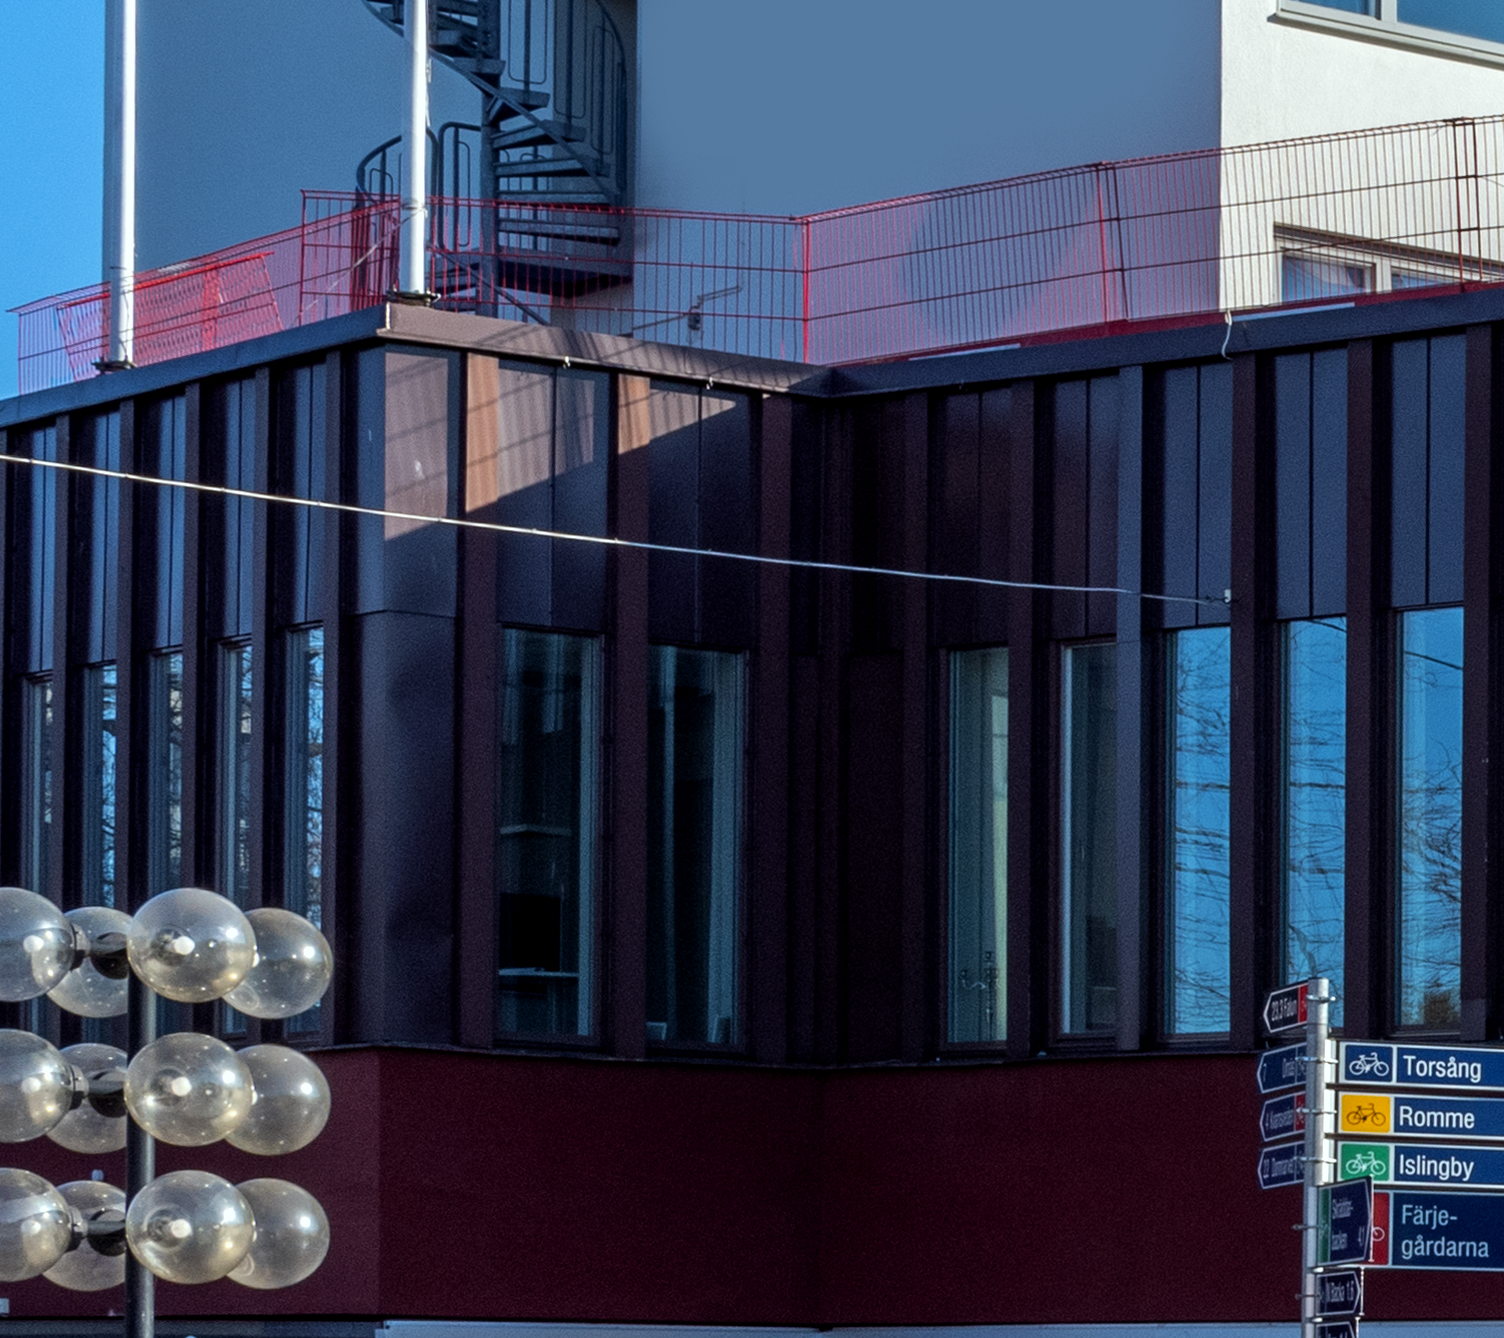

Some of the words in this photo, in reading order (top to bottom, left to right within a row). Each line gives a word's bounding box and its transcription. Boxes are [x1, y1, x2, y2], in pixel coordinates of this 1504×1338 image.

[1403, 1055, 1482, 1083] Torsång
[1399, 1105, 1475, 1129] Romme
[1399, 1154, 1474, 1181] Islingby
[1402, 1205, 1458, 1230] Färje-
[1401, 1235, 1489, 1260] gårdarna
